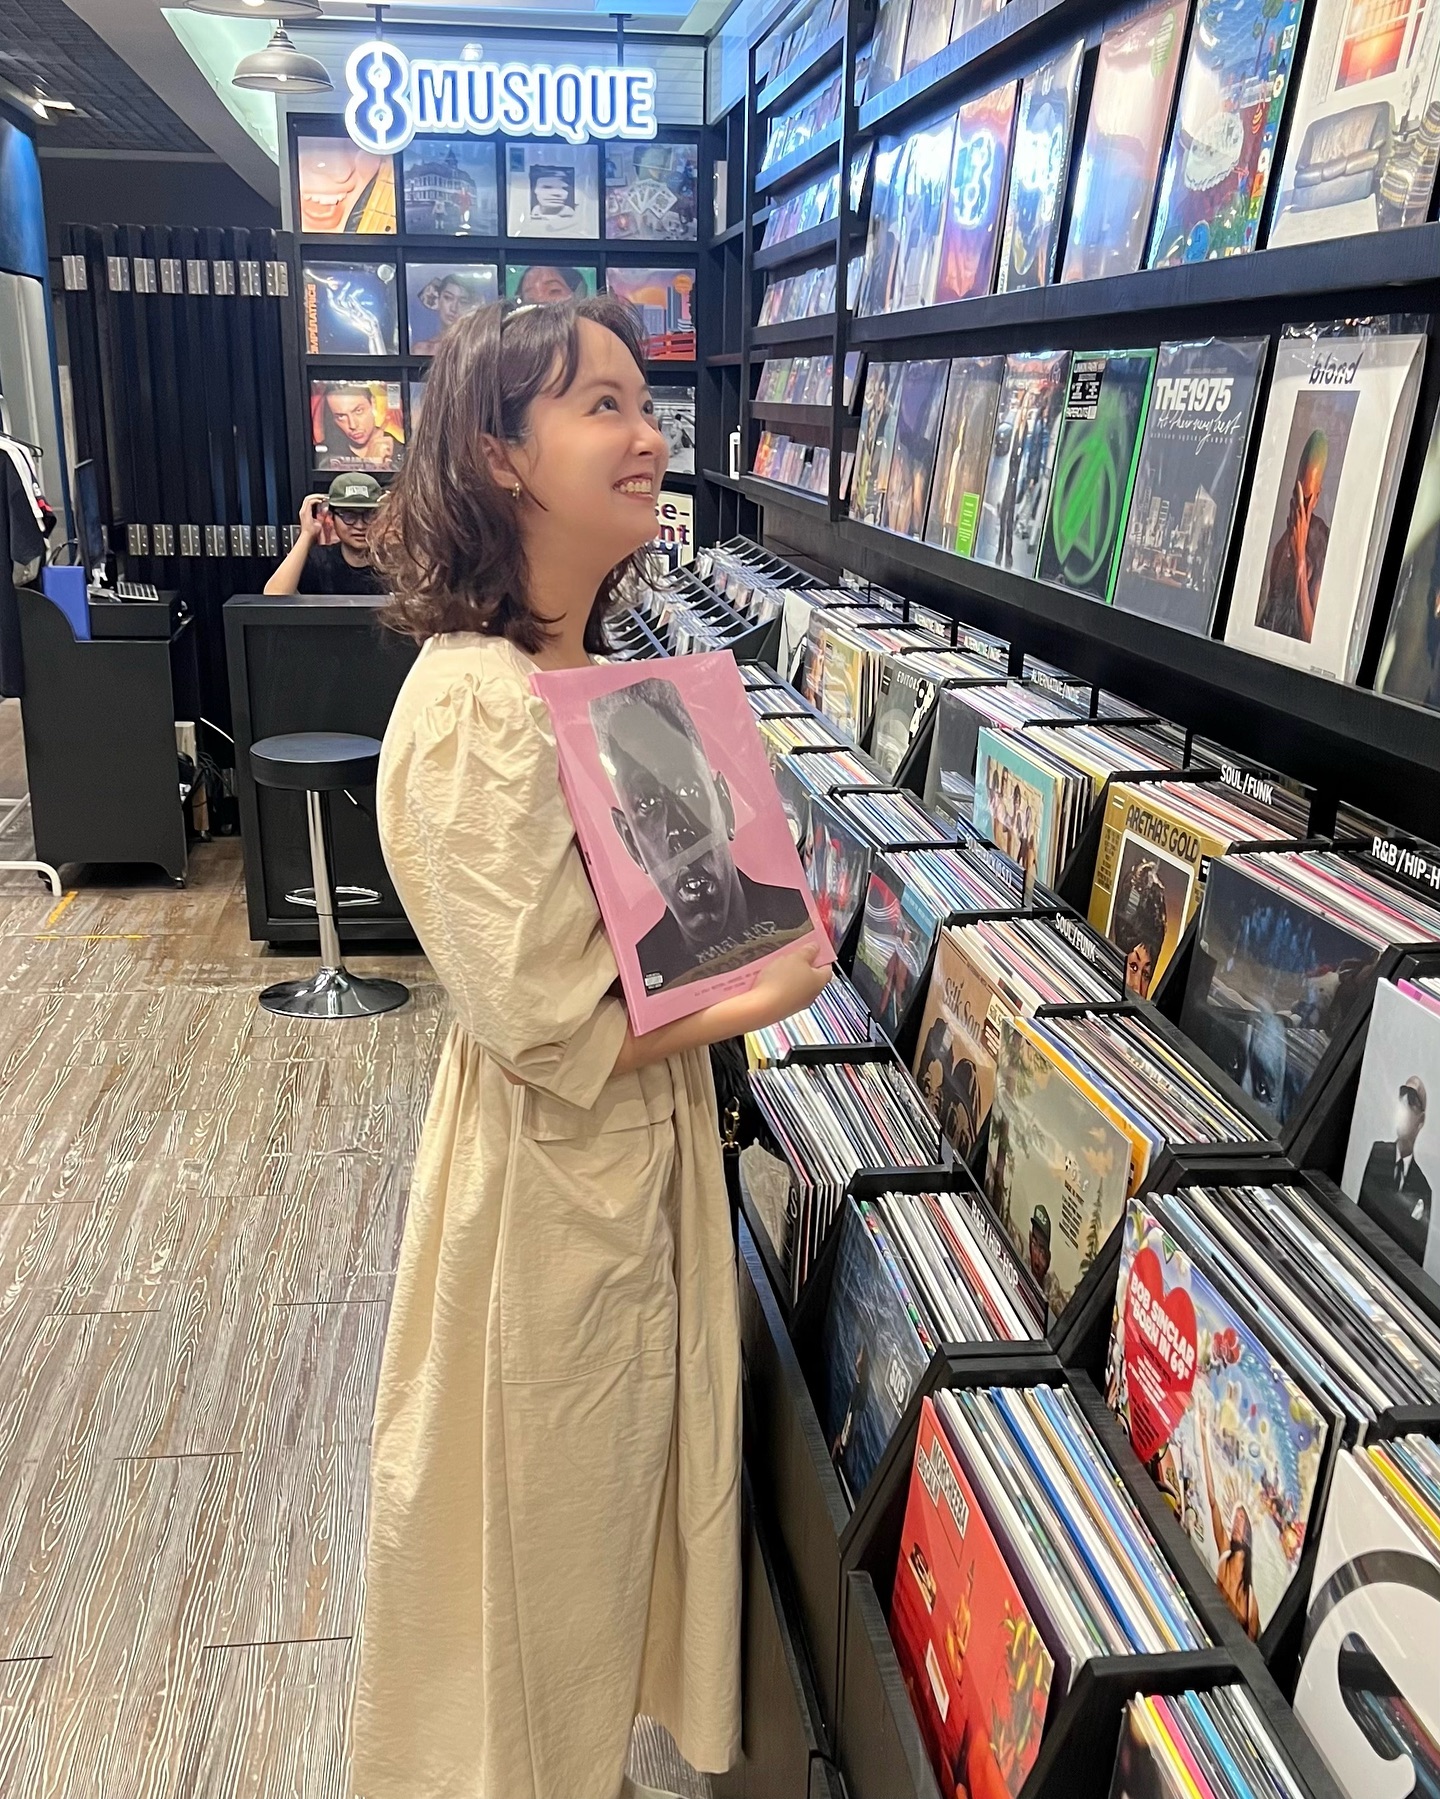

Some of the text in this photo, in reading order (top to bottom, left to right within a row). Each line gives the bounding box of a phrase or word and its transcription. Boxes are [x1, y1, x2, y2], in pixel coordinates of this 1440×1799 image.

[417, 69, 650, 134] MUSIQUE
[1309, 351, 1364, 385] blond
[1220, 764, 1274, 805] SOUL/FUNK
[1125, 804, 1170, 847] ARETHA'S
[1168, 827, 1199, 864] GOLD
[1055, 912, 1096, 963] SOUL/FUNK
[1131, 1271, 1195, 1370] BOB SINCLAR
[1158, 1333, 1171, 1363] IN
[889, 1359, 906, 1404] SOS
